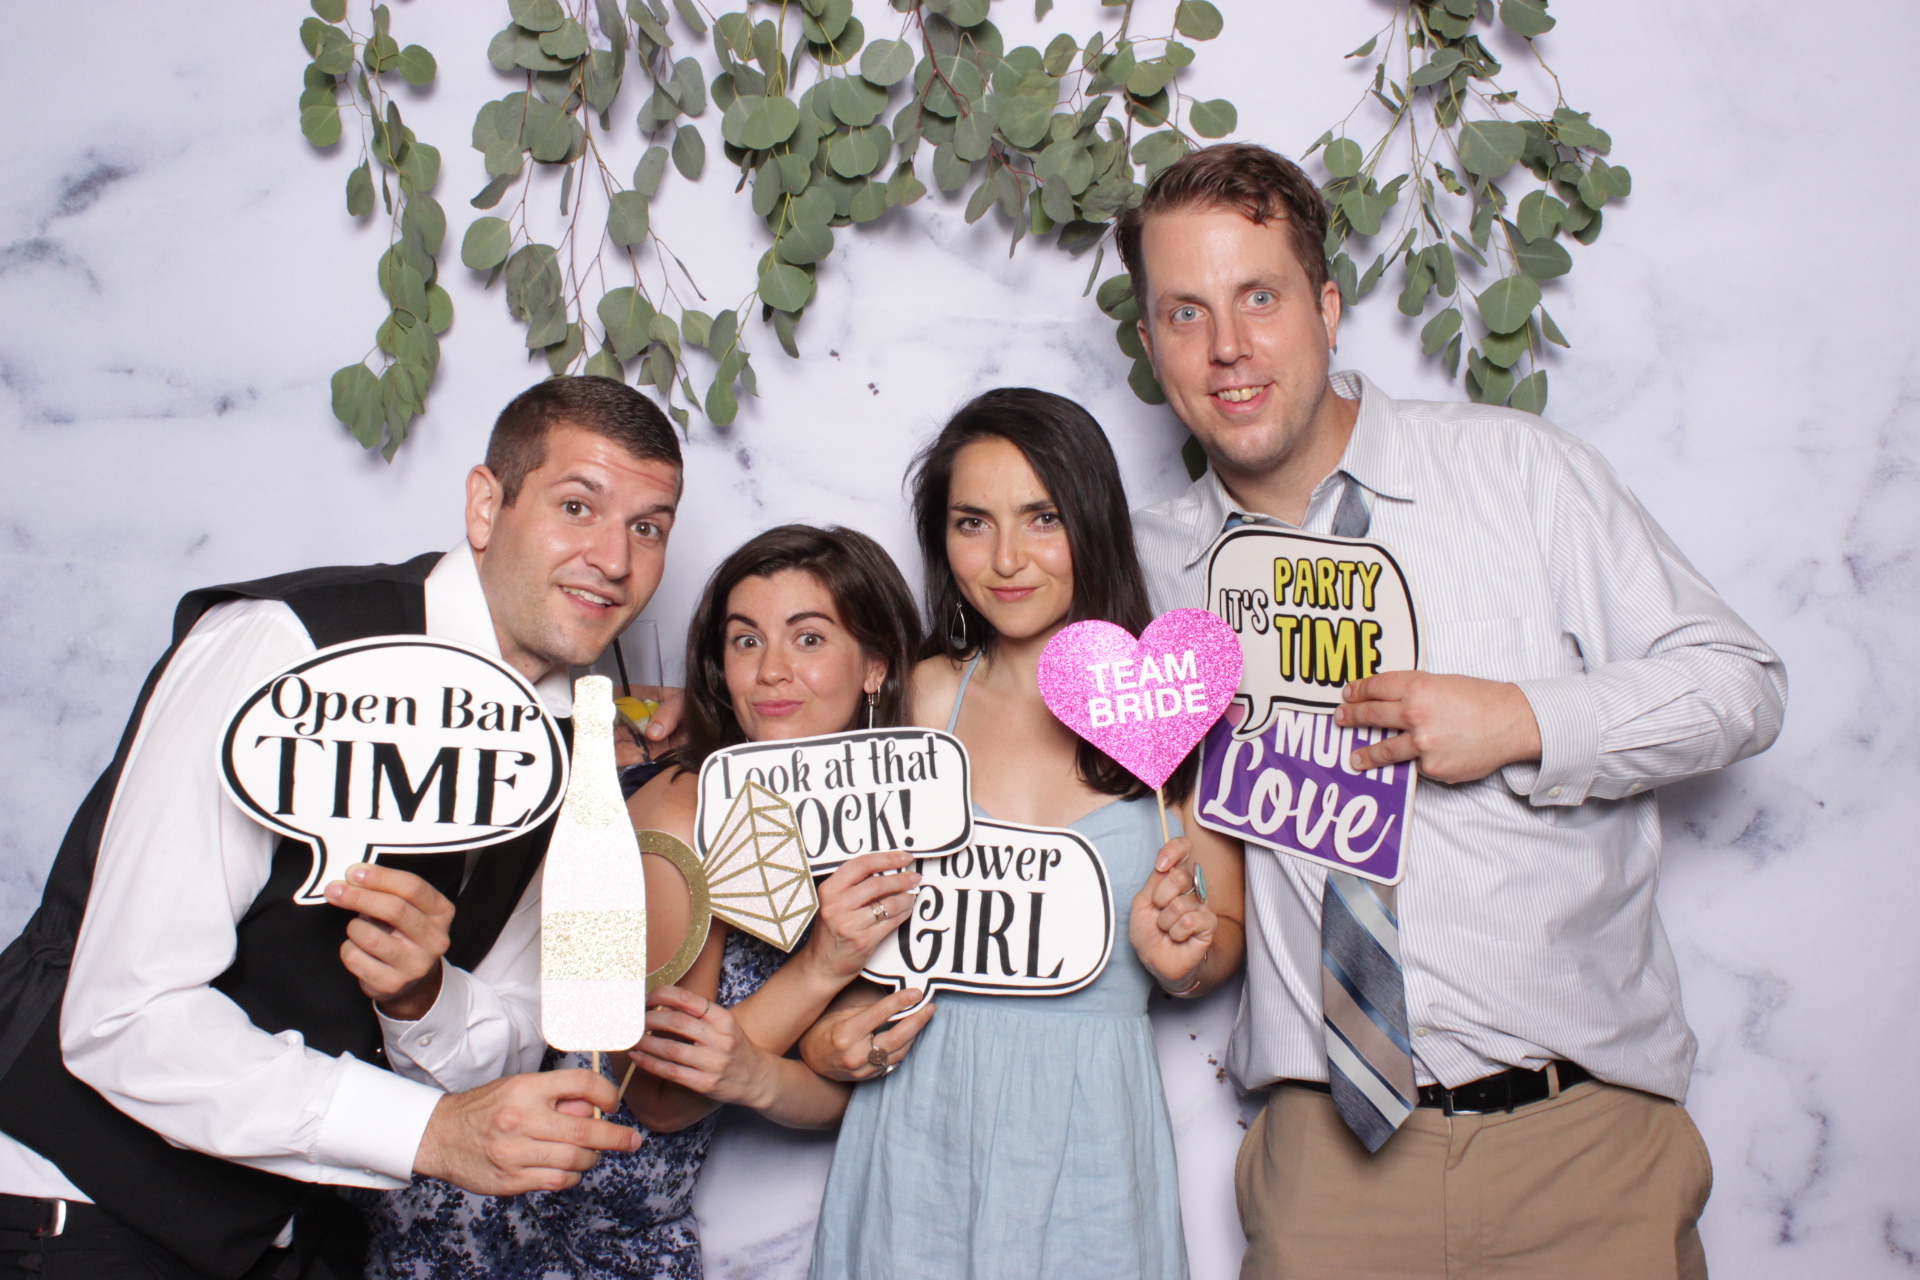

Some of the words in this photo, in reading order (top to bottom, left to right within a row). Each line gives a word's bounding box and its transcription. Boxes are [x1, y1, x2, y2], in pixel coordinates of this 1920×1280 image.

[1219, 588, 1268, 635] IT'S
[1273, 557, 1383, 612] PARTY
[1086, 650, 1198, 693] TEAM
[1273, 614, 1382, 687] TIME
[271, 675, 417, 736] Open
[440, 686, 541, 732] Bar
[1088, 683, 1208, 728] BRIDE
[255, 735, 536, 828] TIME
[824, 743, 856, 789] at
[868, 736, 939, 785] that
[795, 788, 914, 858] OCK!
[1203, 737, 1396, 863] Love
[915, 845, 1062, 881] ower
[898, 884, 1065, 979] GIRL
